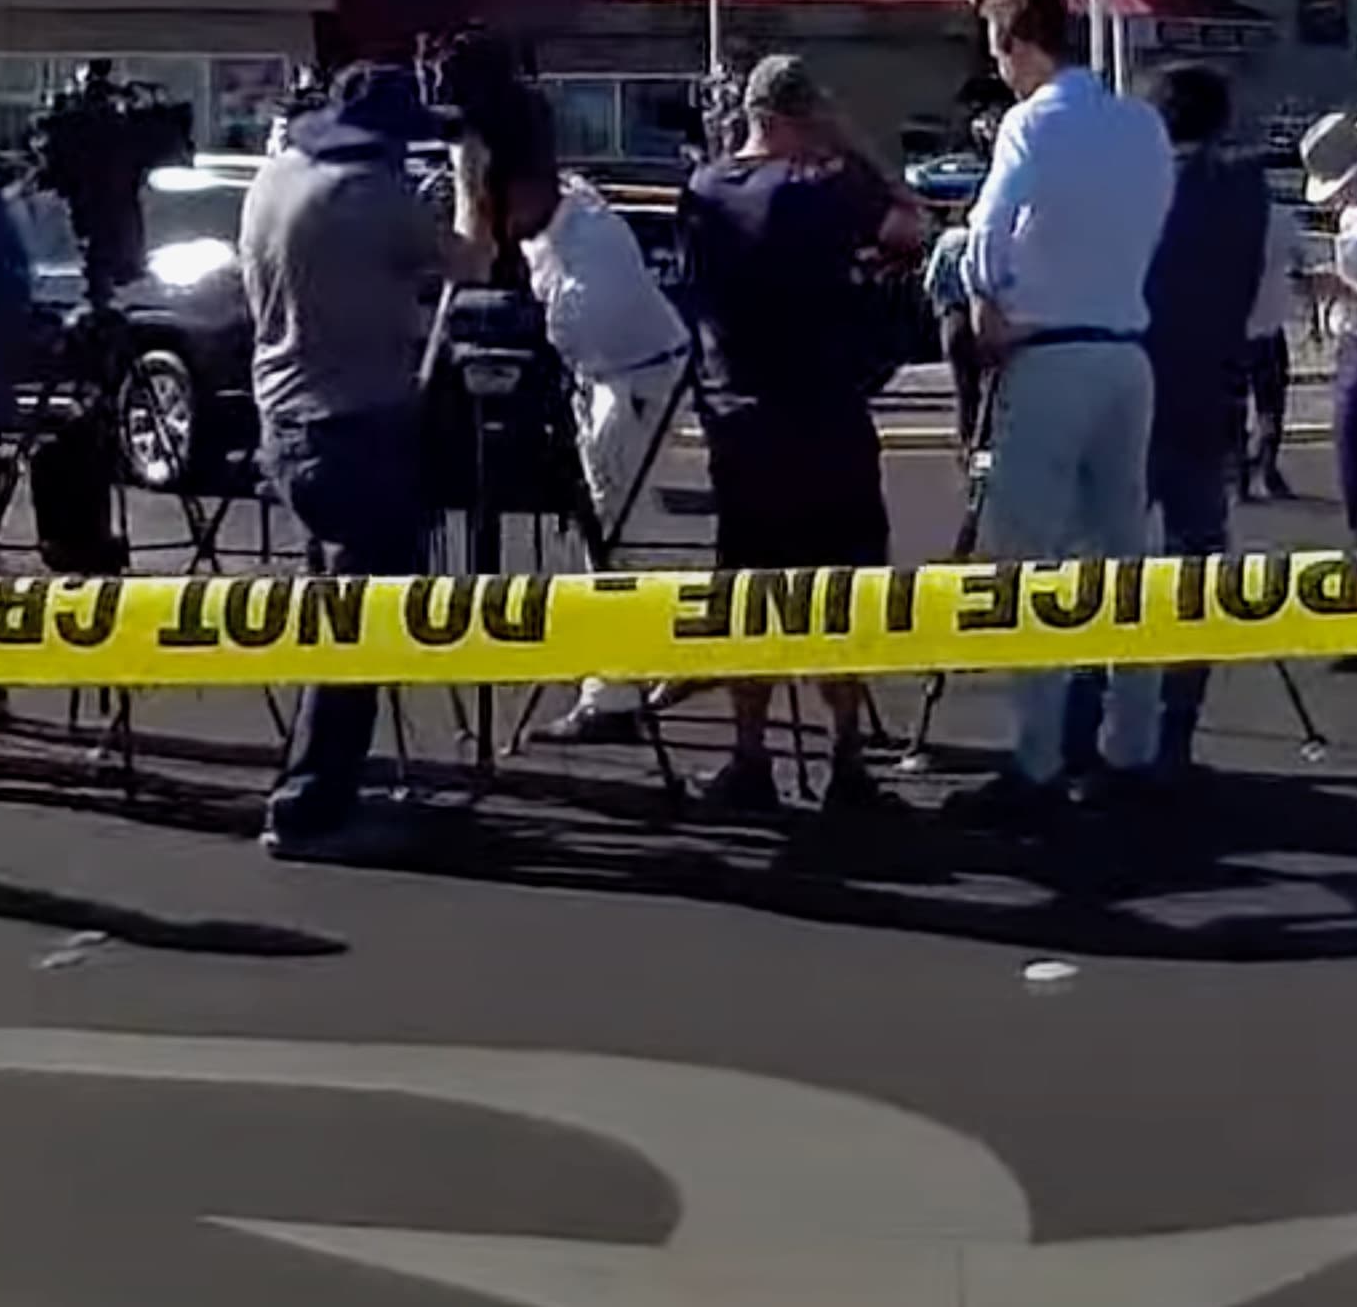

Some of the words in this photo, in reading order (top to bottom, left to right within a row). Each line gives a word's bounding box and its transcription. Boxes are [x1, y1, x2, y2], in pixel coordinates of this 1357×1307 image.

[157, 575, 368, 647] NOT
[404, 575, 551, 645] DO
[674, 567, 920, 637] LINE
